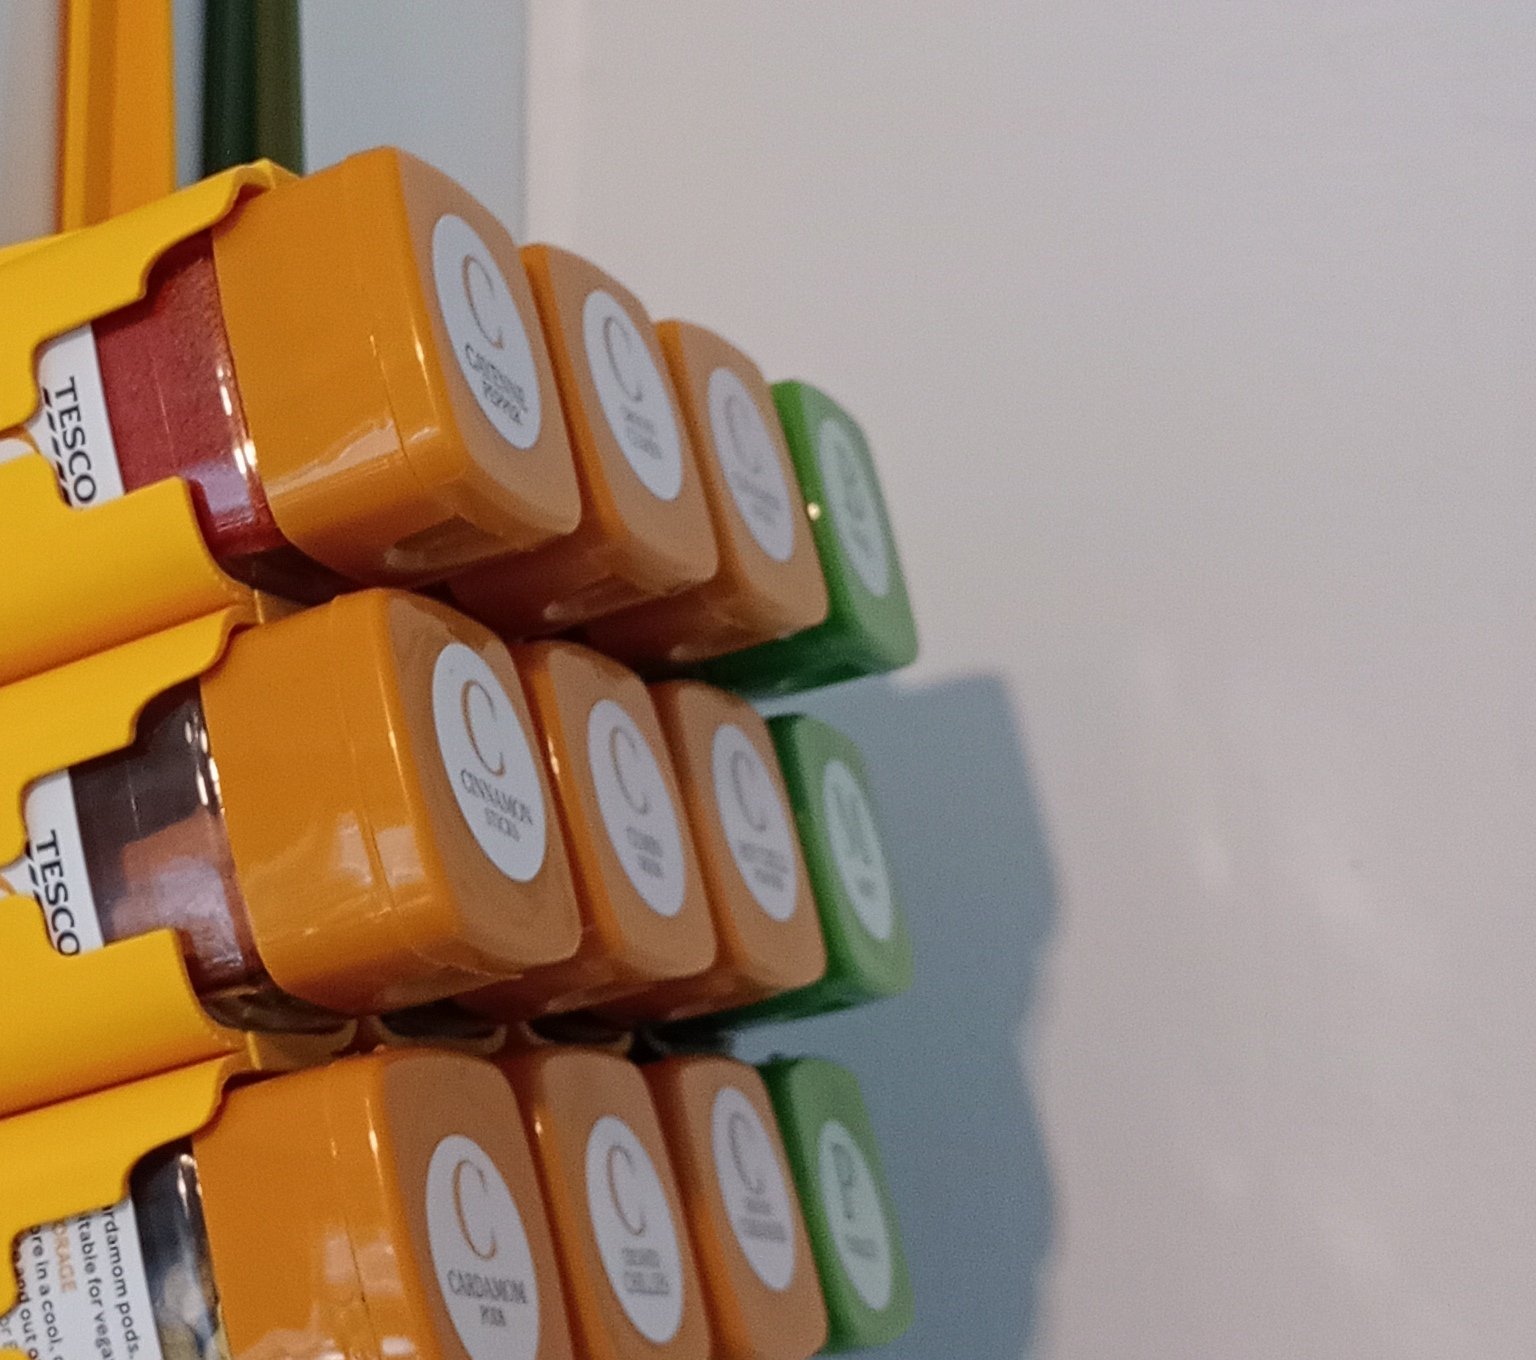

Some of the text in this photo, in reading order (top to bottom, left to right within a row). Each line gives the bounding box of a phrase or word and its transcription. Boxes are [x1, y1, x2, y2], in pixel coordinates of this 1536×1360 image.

[462, 254, 505, 351] C
[603, 316, 643, 403] C
[55, 376, 97, 503] TESCO
[460, 679, 506, 778] C
[608, 726, 648, 815] C
[460, 768, 534, 826] CINNAMON
[36, 829, 82, 956] TESCO
[452, 1159, 498, 1260] C
[607, 1144, 646, 1237] C
[35, 1259, 48, 1280] in
[39, 1284, 50, 1297] a
[88, 1278, 103, 1307] for
[447, 1269, 529, 1305] CARDAMOM
[20, 1308, 37, 1342] out
